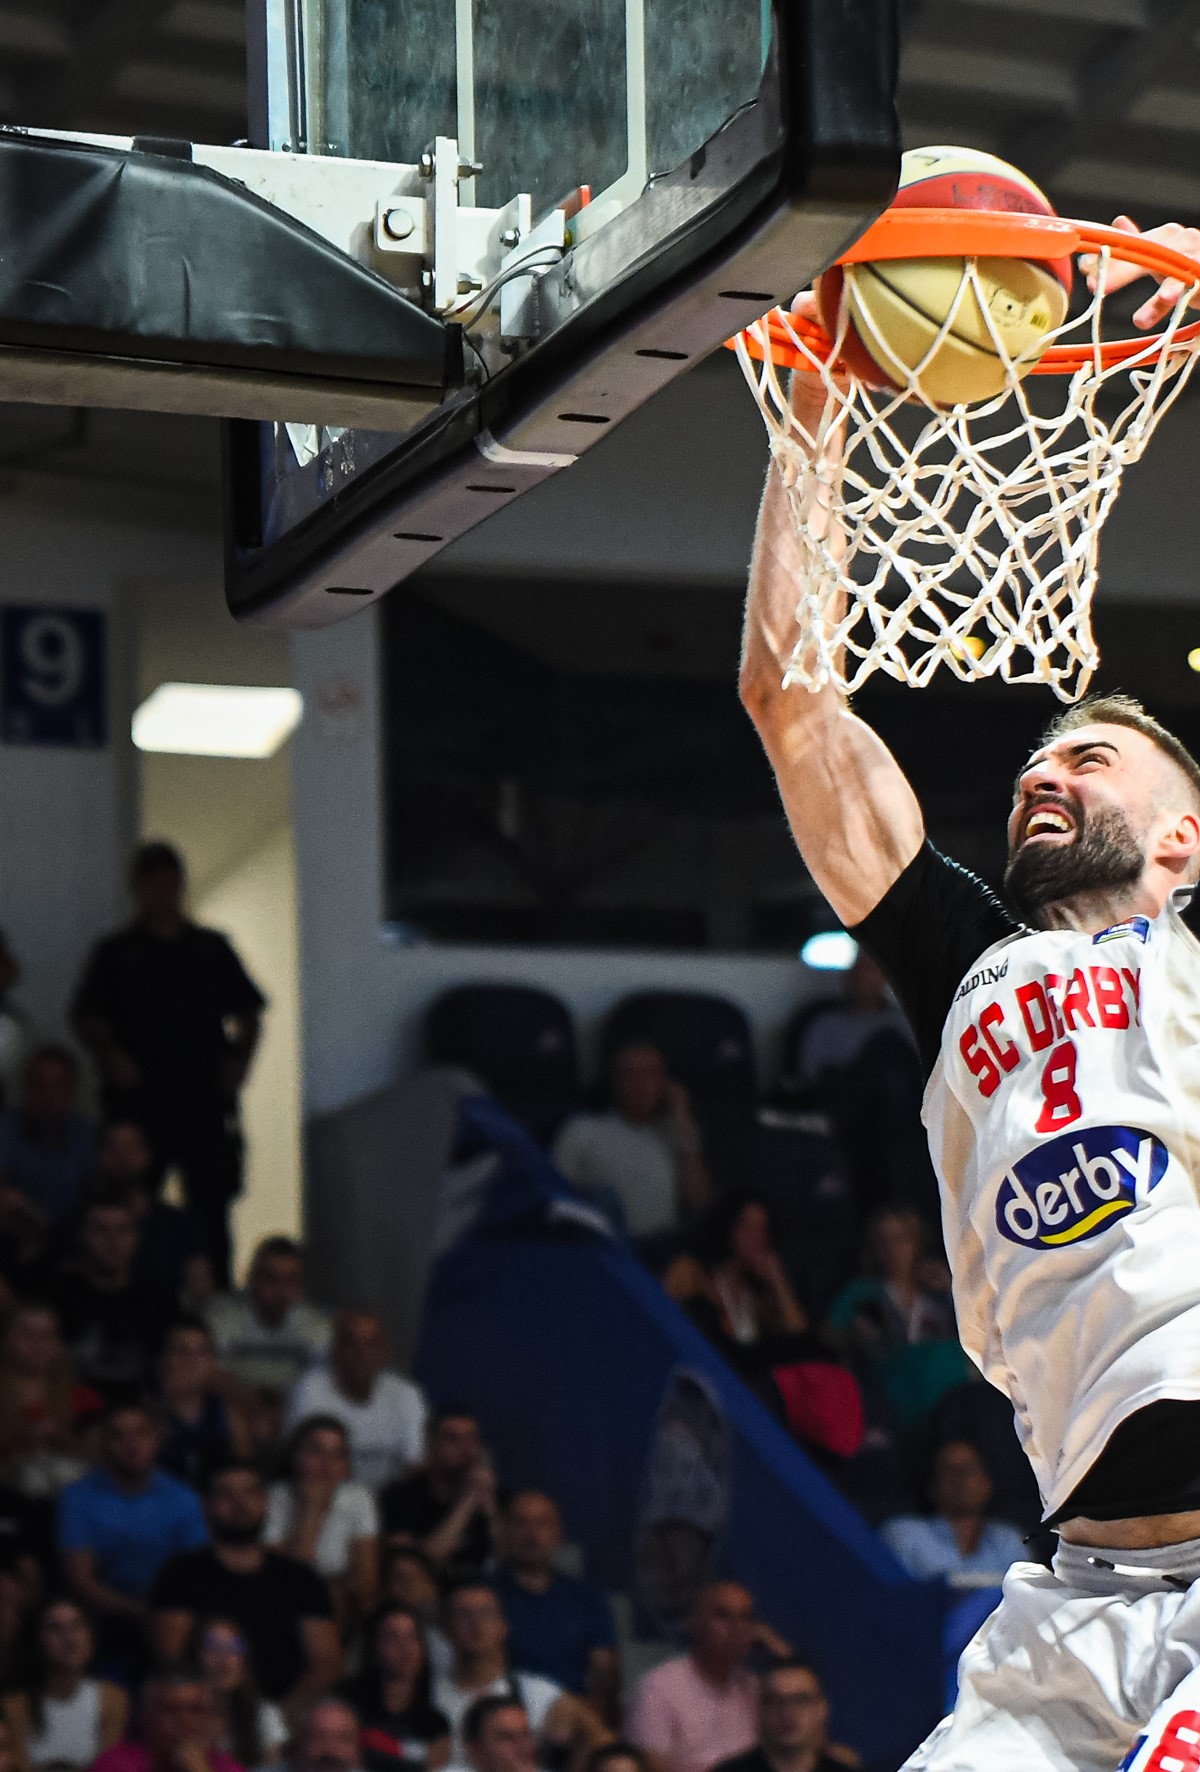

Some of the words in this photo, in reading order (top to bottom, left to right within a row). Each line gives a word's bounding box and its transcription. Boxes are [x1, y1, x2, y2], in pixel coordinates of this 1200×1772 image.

[22, 615, 84, 705] 9
[954, 958, 1009, 1002] ALDING
[959, 1001, 1021, 1098] SC
[1034, 1040, 1082, 1133] 8
[1004, 1137, 1153, 1240] derby
